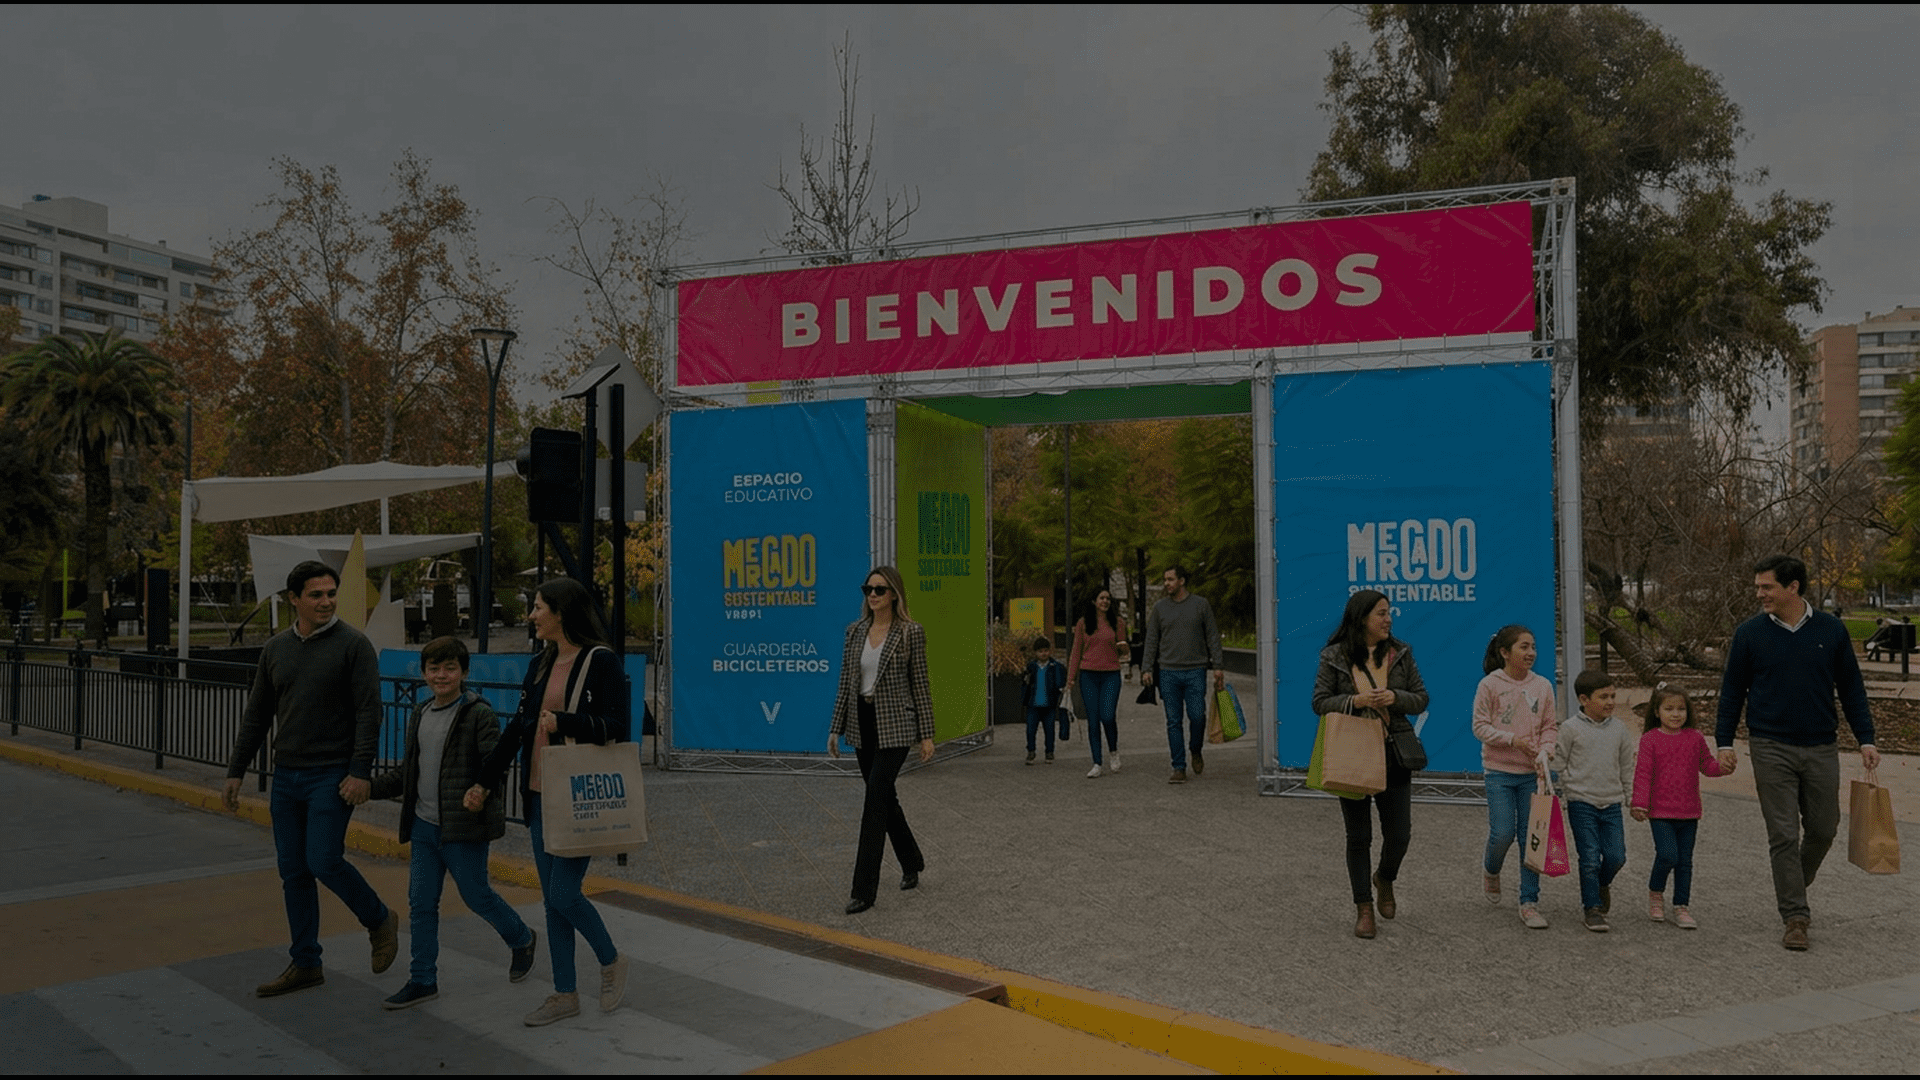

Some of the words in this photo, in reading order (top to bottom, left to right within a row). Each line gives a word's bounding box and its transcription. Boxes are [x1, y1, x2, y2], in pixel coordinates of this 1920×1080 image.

[782, 253, 1383, 348] BIENVENIDOS
[724, 487, 813, 503] EDUCATIVO
[724, 590, 817, 607] SUSTENTABLE
[723, 638, 818, 656] GUARDERÍA
[713, 658, 830, 673] BICICLETEROS
